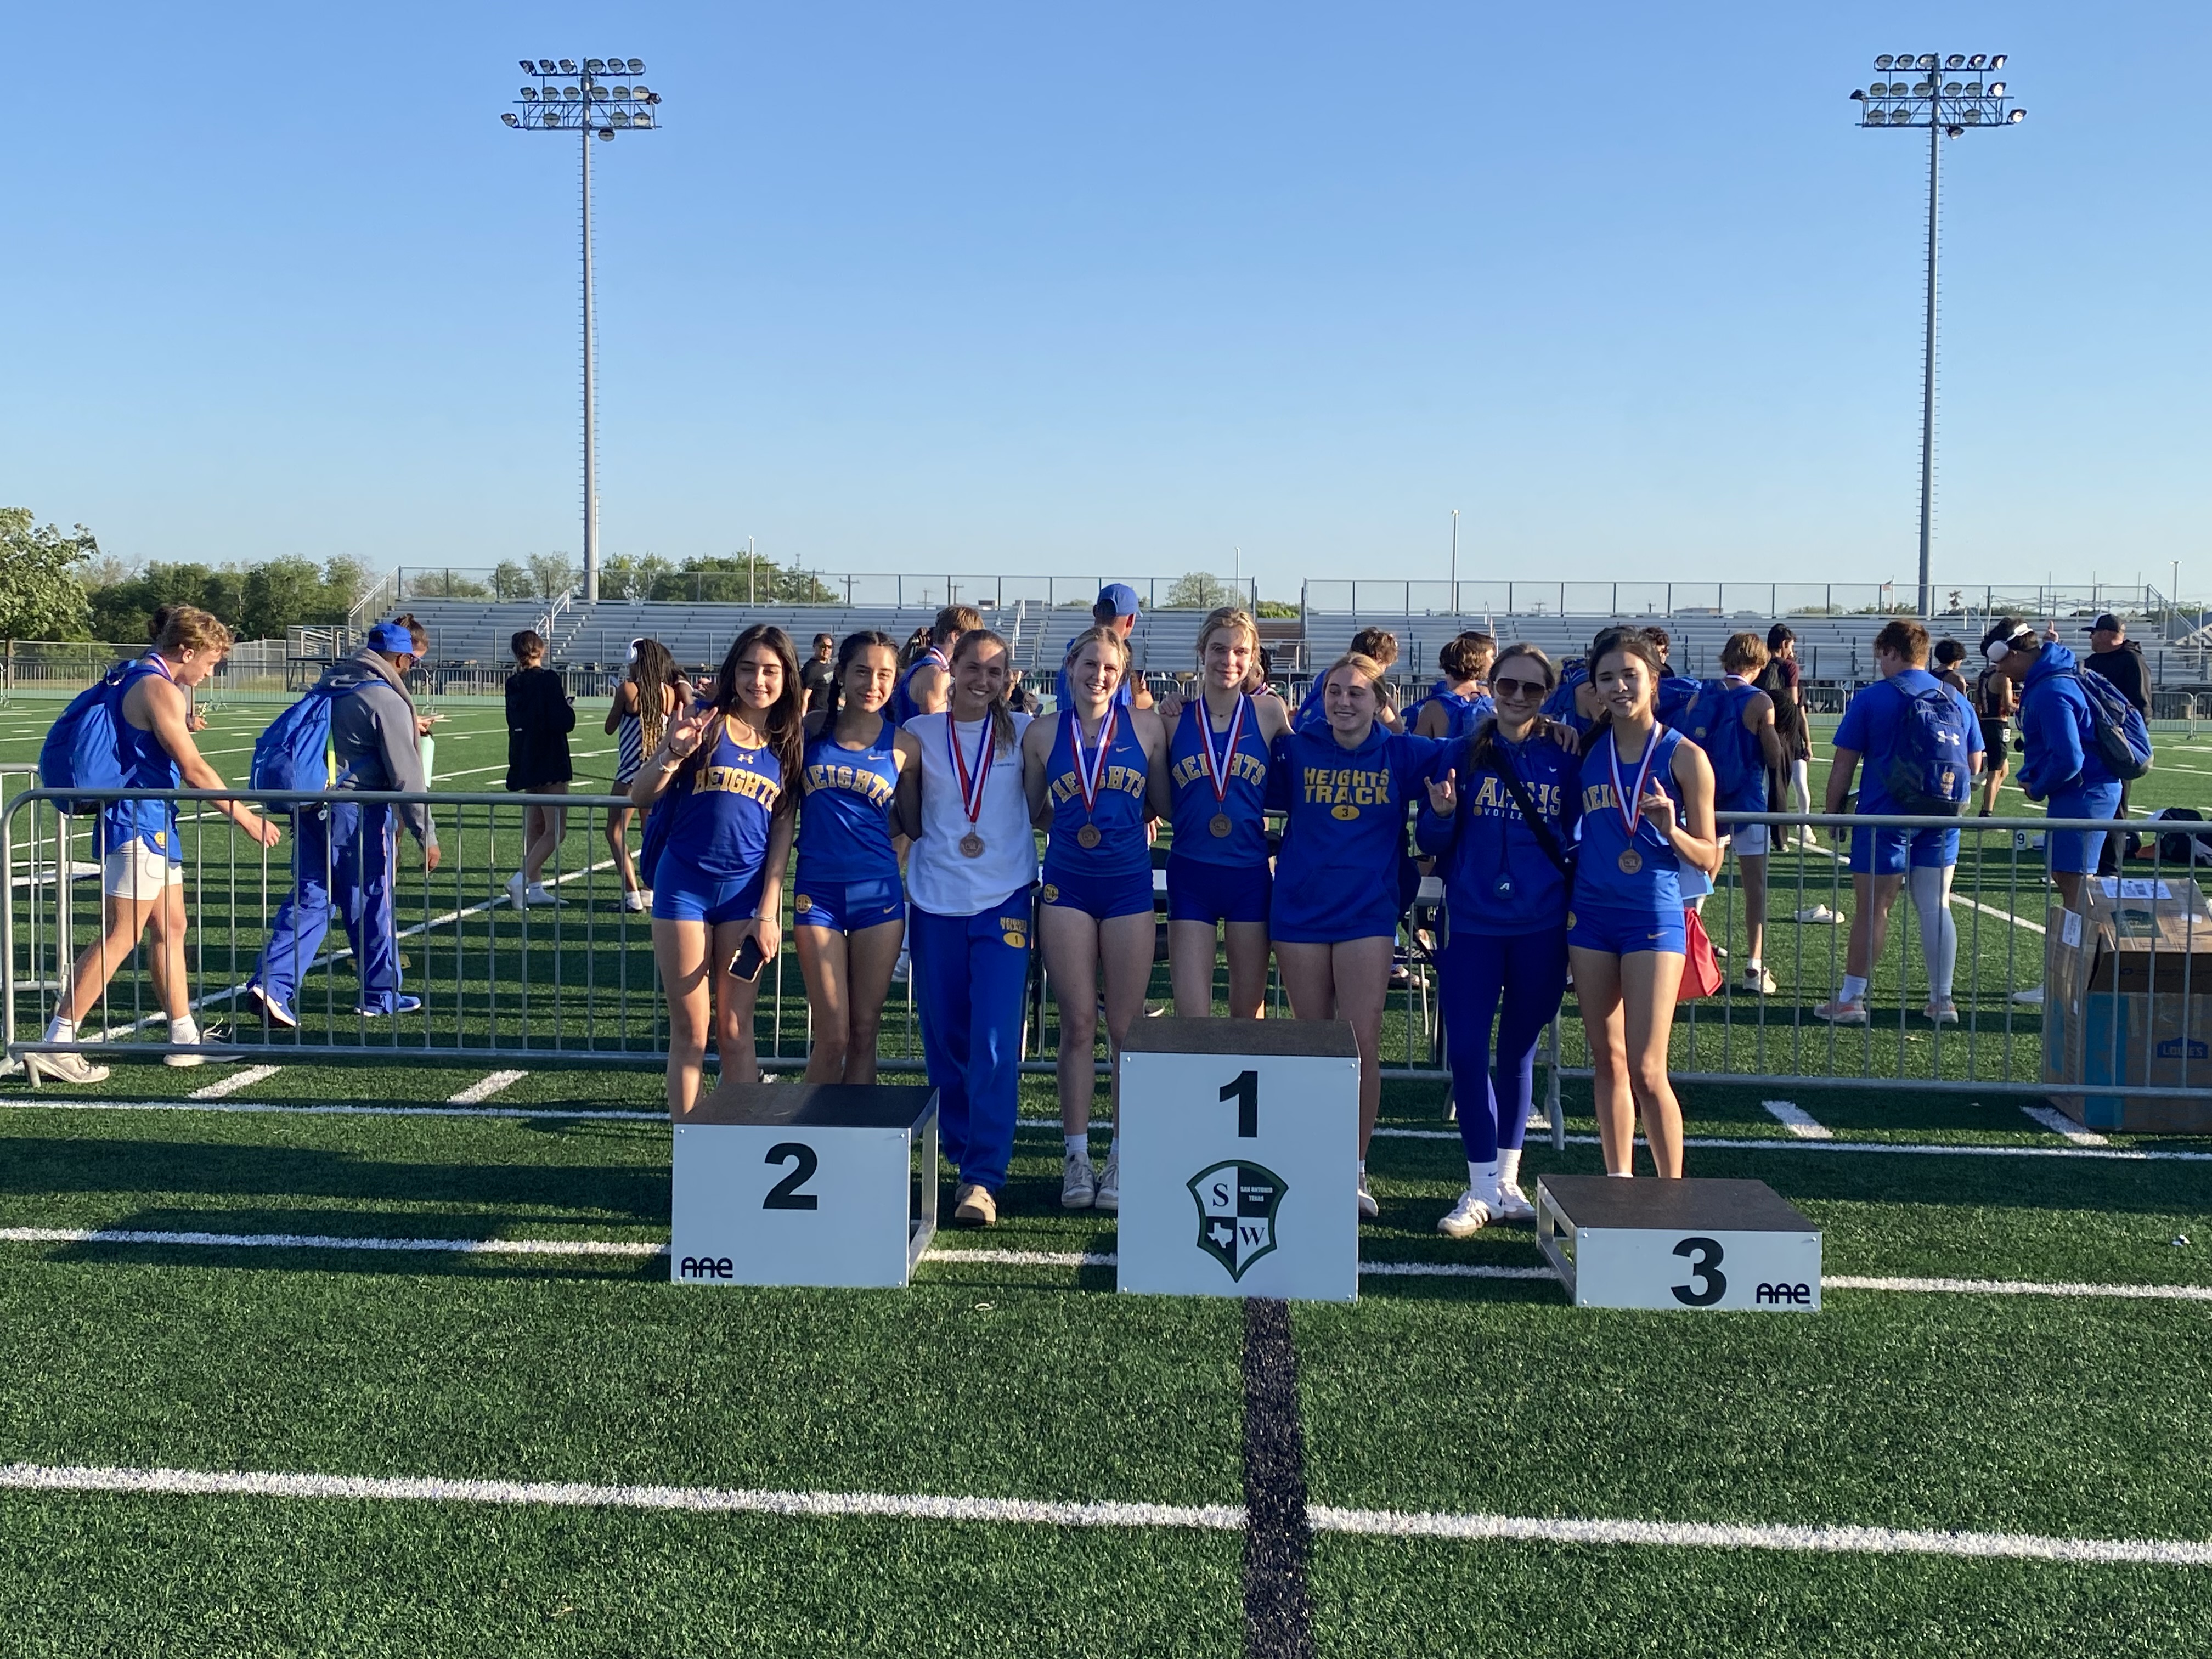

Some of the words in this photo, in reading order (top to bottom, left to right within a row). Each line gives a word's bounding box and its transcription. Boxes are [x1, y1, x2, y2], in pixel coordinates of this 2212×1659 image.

[1304, 767, 1390, 787] HEIGHTS
[1304, 785, 1391, 805] TRACK
[1342, 808, 1349, 817] 3
[2017, 833, 2025, 845] 9
[1219, 1070, 1258, 1138] 1
[763, 1142, 817, 1210] 2
[1212, 1183, 1229, 1207] S
[1239, 1227, 1265, 1246] W
[1671, 1237, 1727, 1306] 3
